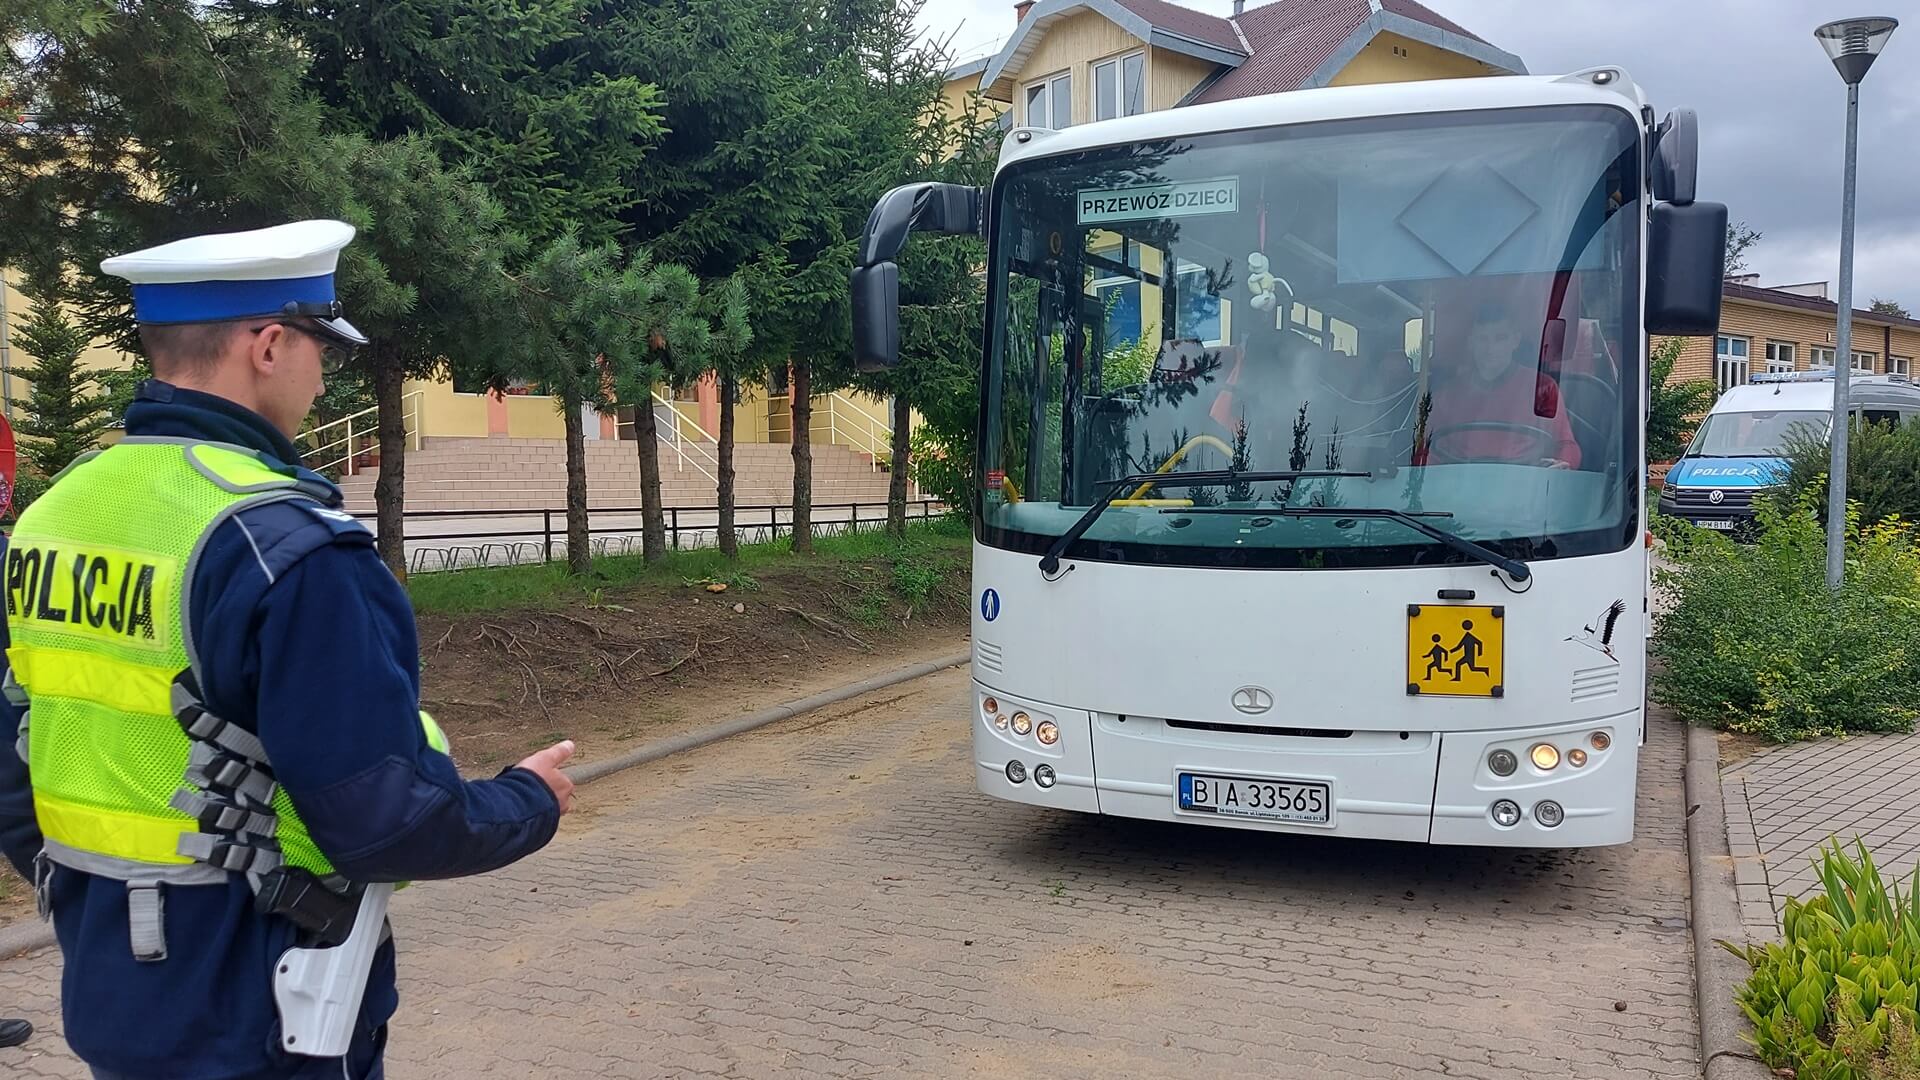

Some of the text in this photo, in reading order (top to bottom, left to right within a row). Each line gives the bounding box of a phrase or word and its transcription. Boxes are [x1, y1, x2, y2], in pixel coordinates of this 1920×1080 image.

[1083, 188, 1233, 215] PRZEWÓZ DZIECI
[1693, 468, 1759, 476] POLICJA
[8, 548, 155, 640] POLICJA
[1194, 780, 1322, 812] BIA 33565
